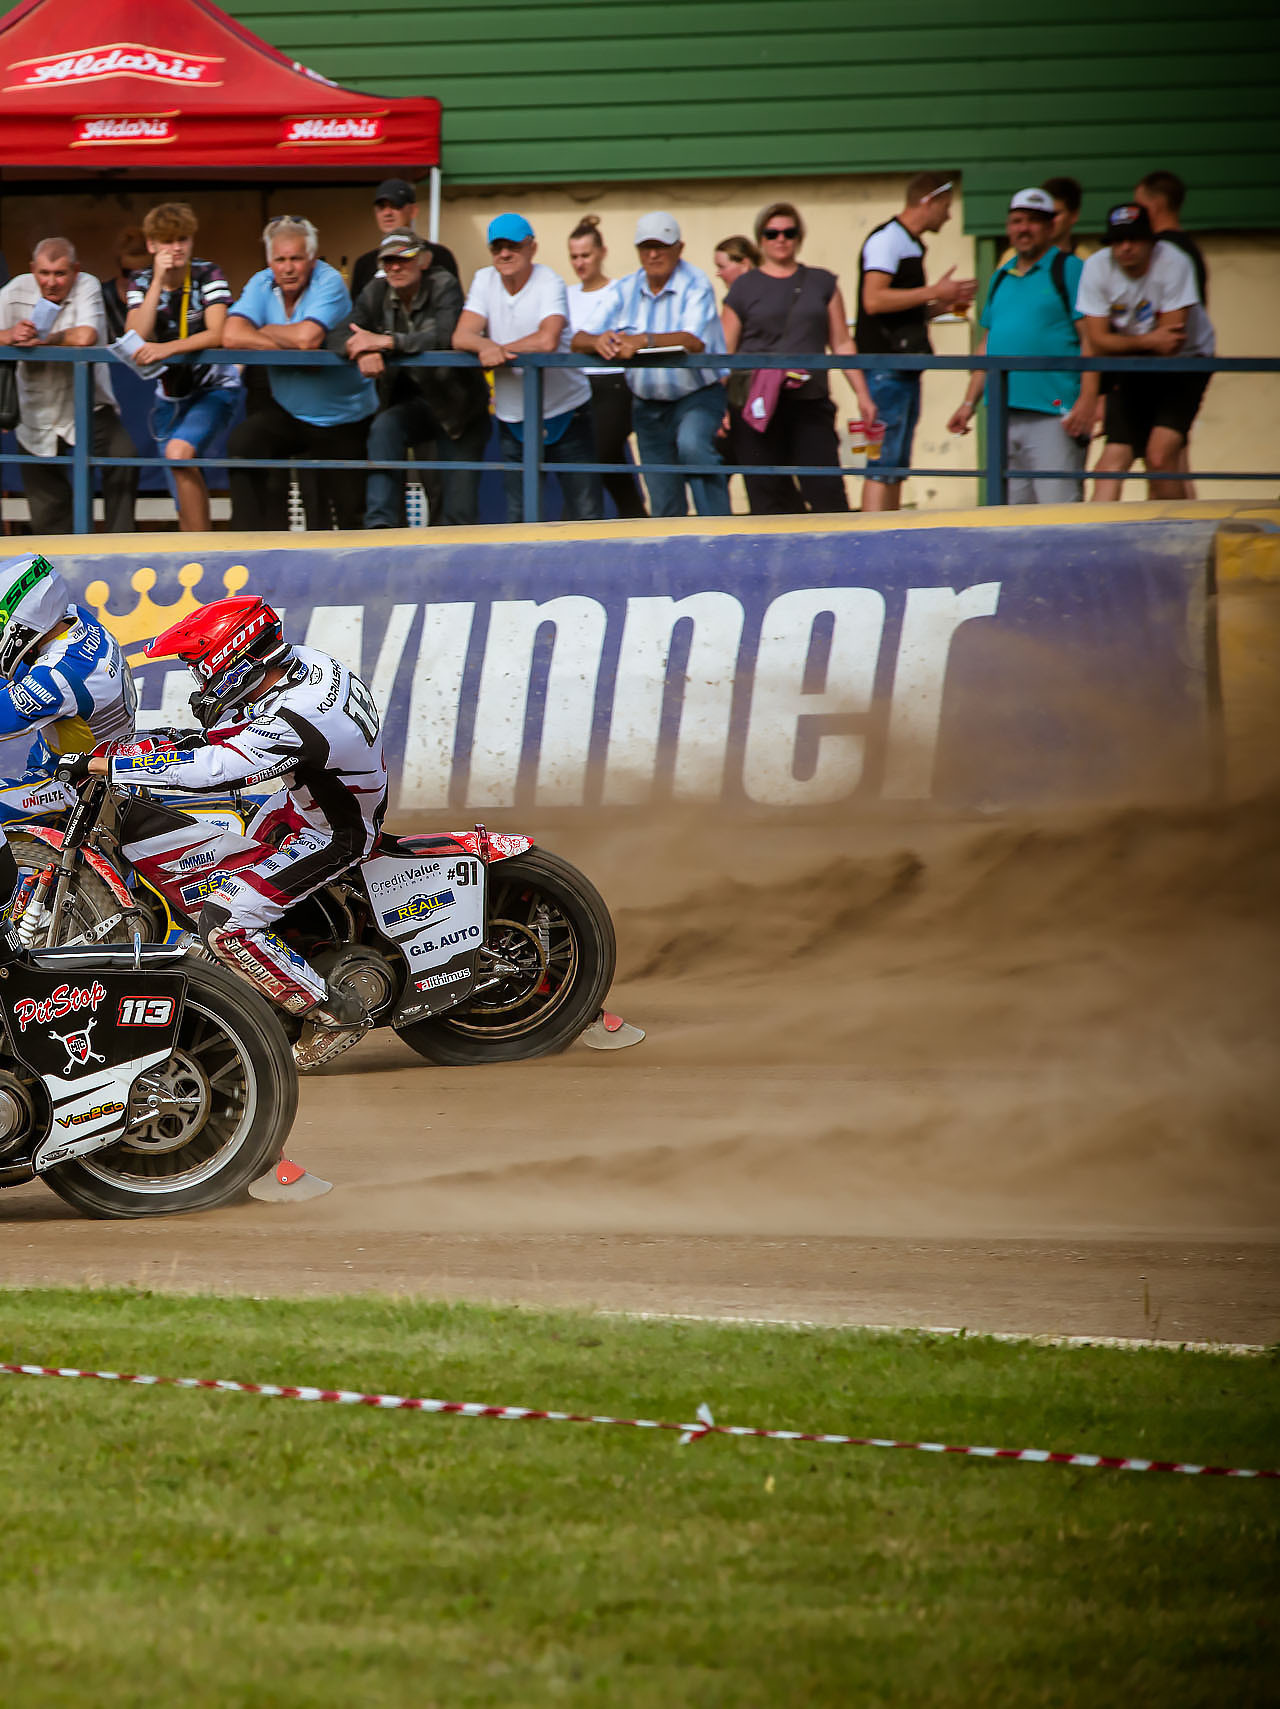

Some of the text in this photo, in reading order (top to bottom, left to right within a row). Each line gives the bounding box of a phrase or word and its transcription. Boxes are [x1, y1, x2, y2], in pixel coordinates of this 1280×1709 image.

[25, 50, 205, 83] Aldaris
[79, 119, 168, 141] Aldaris
[287, 119, 378, 140] Aldaris
[212, 612, 266, 668] SCOTT
[132, 752, 182, 768] REALL
[447, 860, 479, 887] #91
[397, 896, 444, 920] REALL
[409, 925, 480, 957] G.B. AUTO
[14, 980, 107, 1033] PitStop
[121, 999, 172, 1025] 113
[55, 1101, 126, 1129] Van2Go
